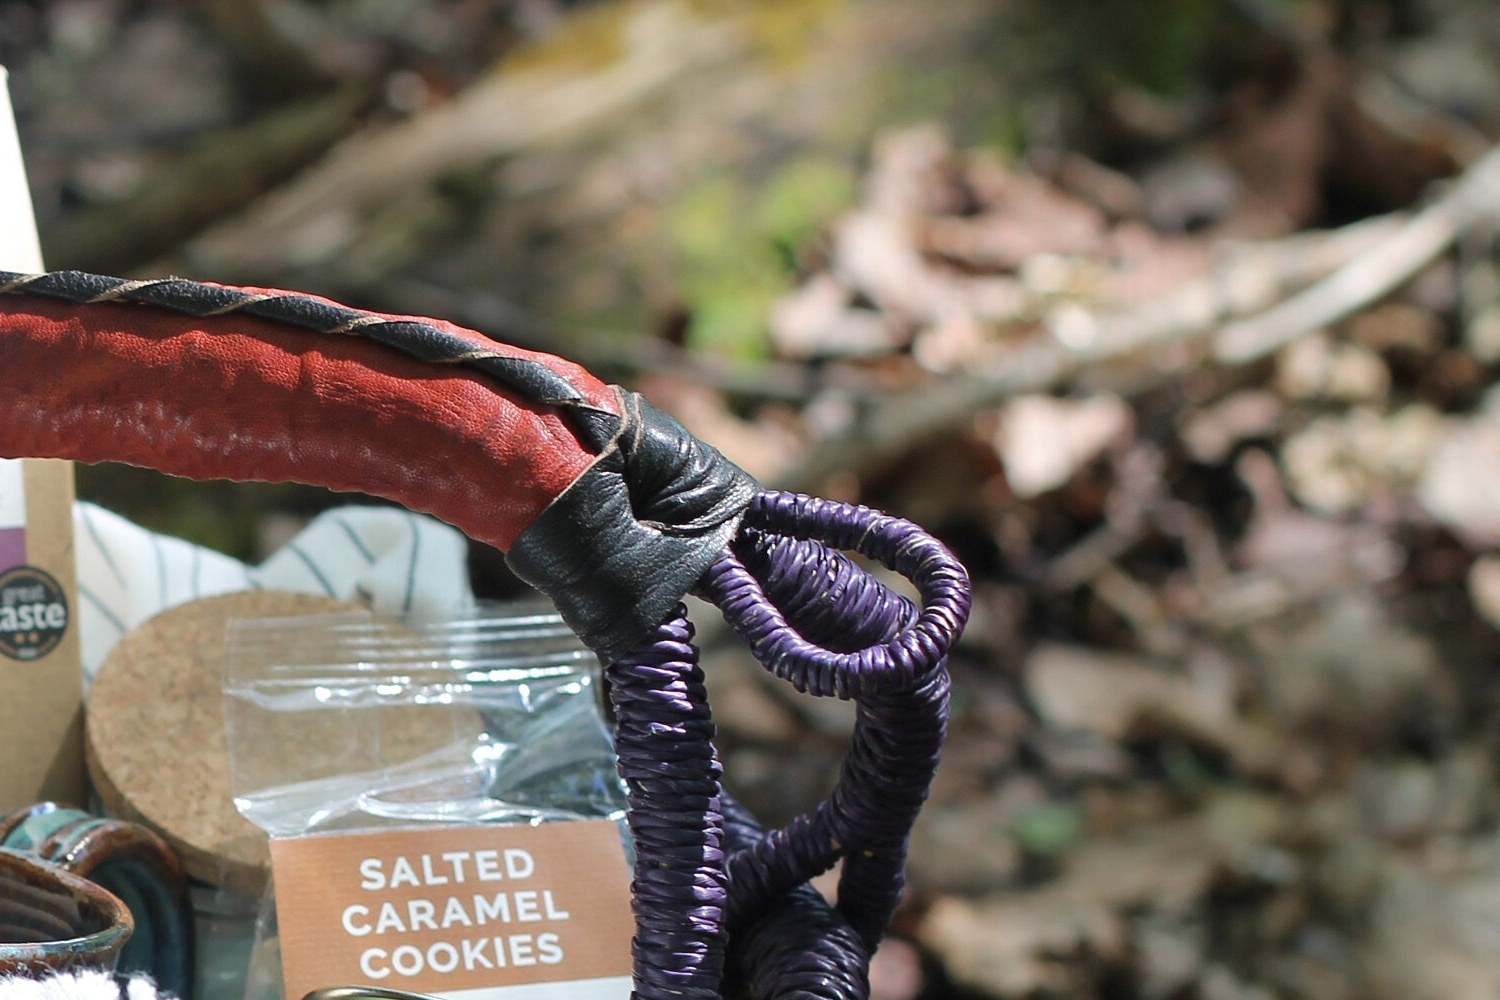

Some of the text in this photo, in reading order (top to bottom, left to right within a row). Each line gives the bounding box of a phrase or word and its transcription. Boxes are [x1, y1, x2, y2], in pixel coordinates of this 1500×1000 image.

[359, 848, 536, 891] SALTED
[341, 889, 570, 937] CARAMEL
[359, 933, 565, 979] COOKIES
